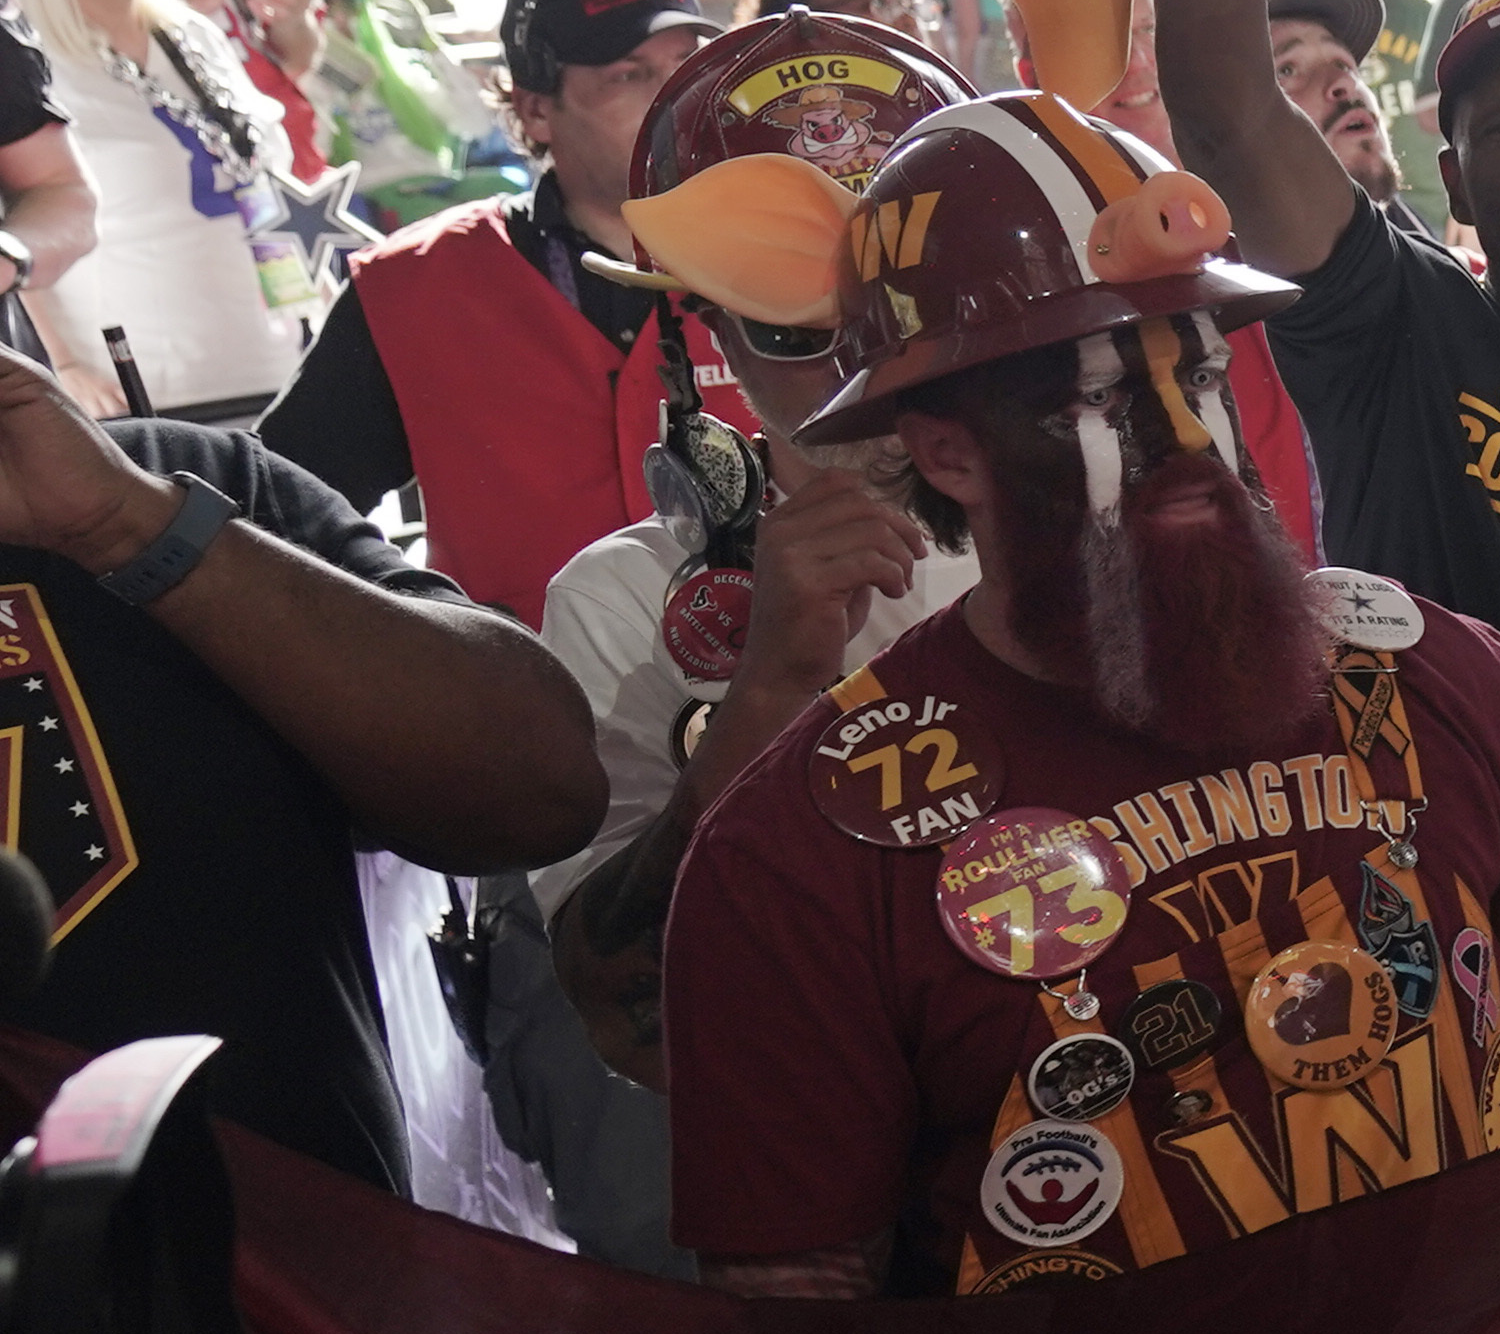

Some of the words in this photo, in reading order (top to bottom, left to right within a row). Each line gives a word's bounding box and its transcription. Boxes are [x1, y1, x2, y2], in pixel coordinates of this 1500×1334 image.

[776, 59, 850, 88] HOG
[718, 611, 733, 627] VS
[817, 700, 911, 761] Leno
[915, 695, 958, 727] Jr
[846, 728, 979, 811] 72
[890, 791, 981, 846] FAN
[942, 819, 1093, 893] ROULLIER
[990, 830, 1014, 848] I'M
[1011, 861, 1047, 884] FAN
[1364, 971, 1390, 1043] HOGS
[1131, 987, 1216, 1067] 21
[1292, 1047, 1373, 1082] THEM
[1011, 1133, 1034, 1152] Pro
[1037, 1129, 1098, 1150] Football's
[995, 1203, 1028, 1236] Ultimate
[1029, 1223, 1051, 1240] Fan
[1051, 1201, 1106, 1240] Association
